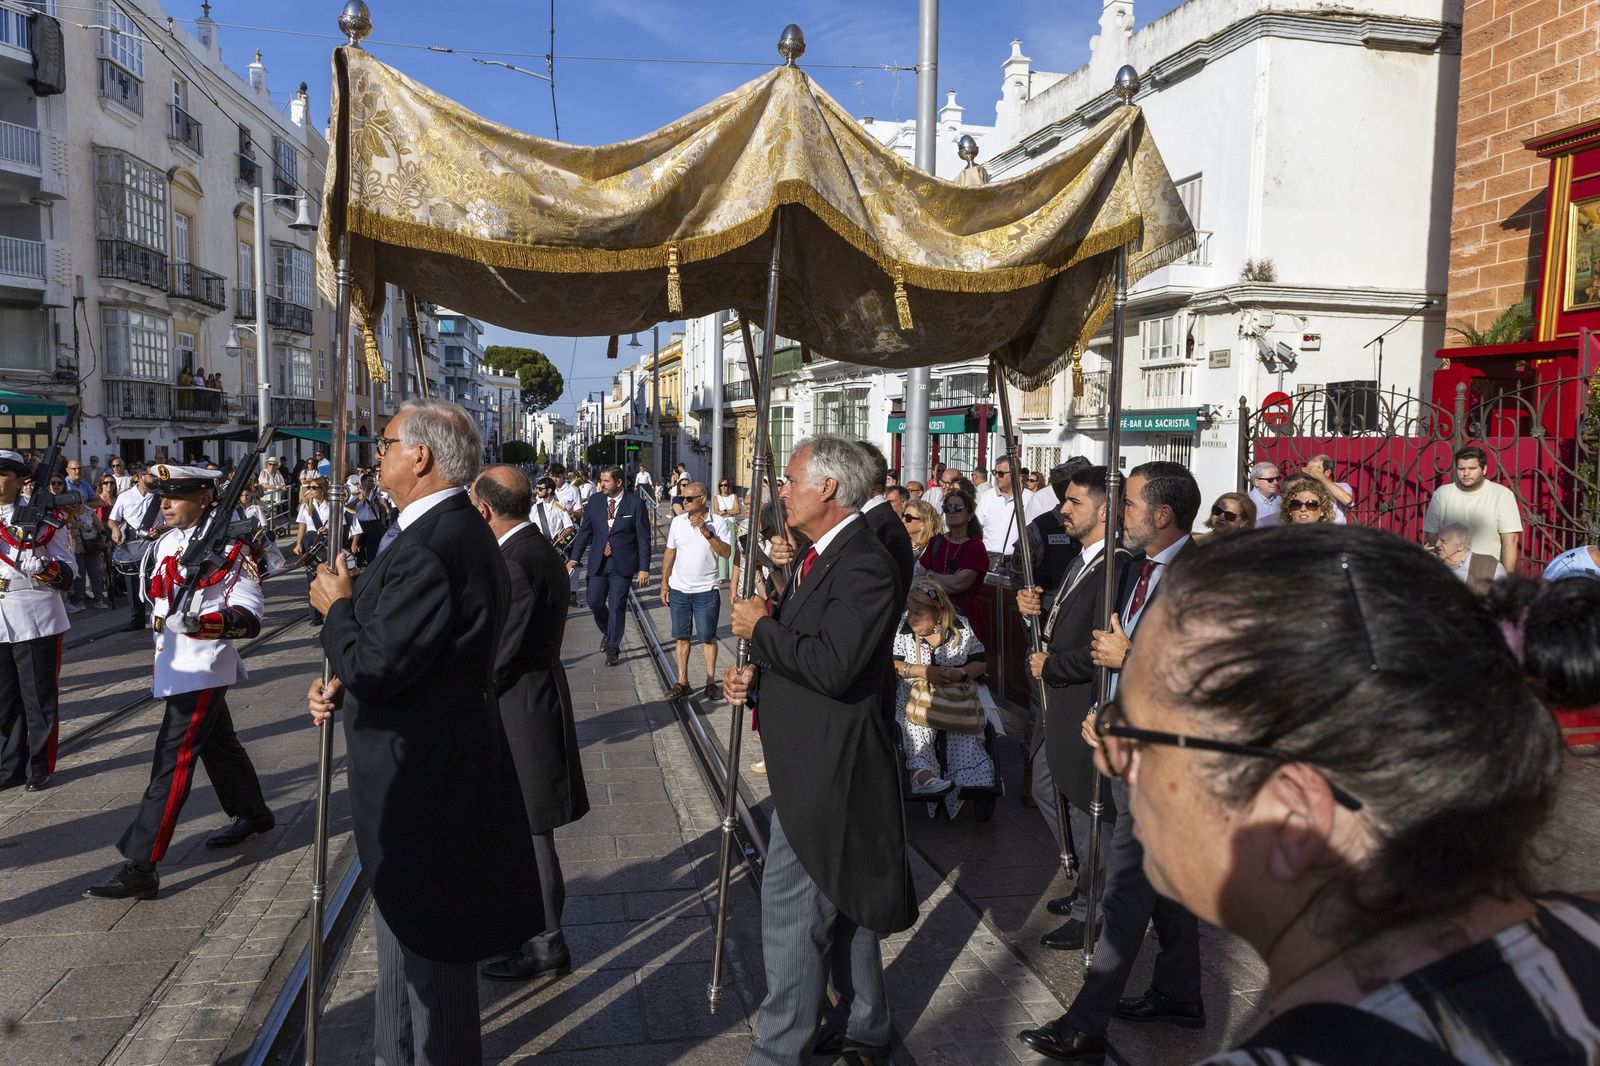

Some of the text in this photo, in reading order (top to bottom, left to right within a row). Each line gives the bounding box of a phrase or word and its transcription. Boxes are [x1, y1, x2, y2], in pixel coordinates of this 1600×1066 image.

[1120, 418, 1190, 428] FÉ-BAR LA SACRISTIA
